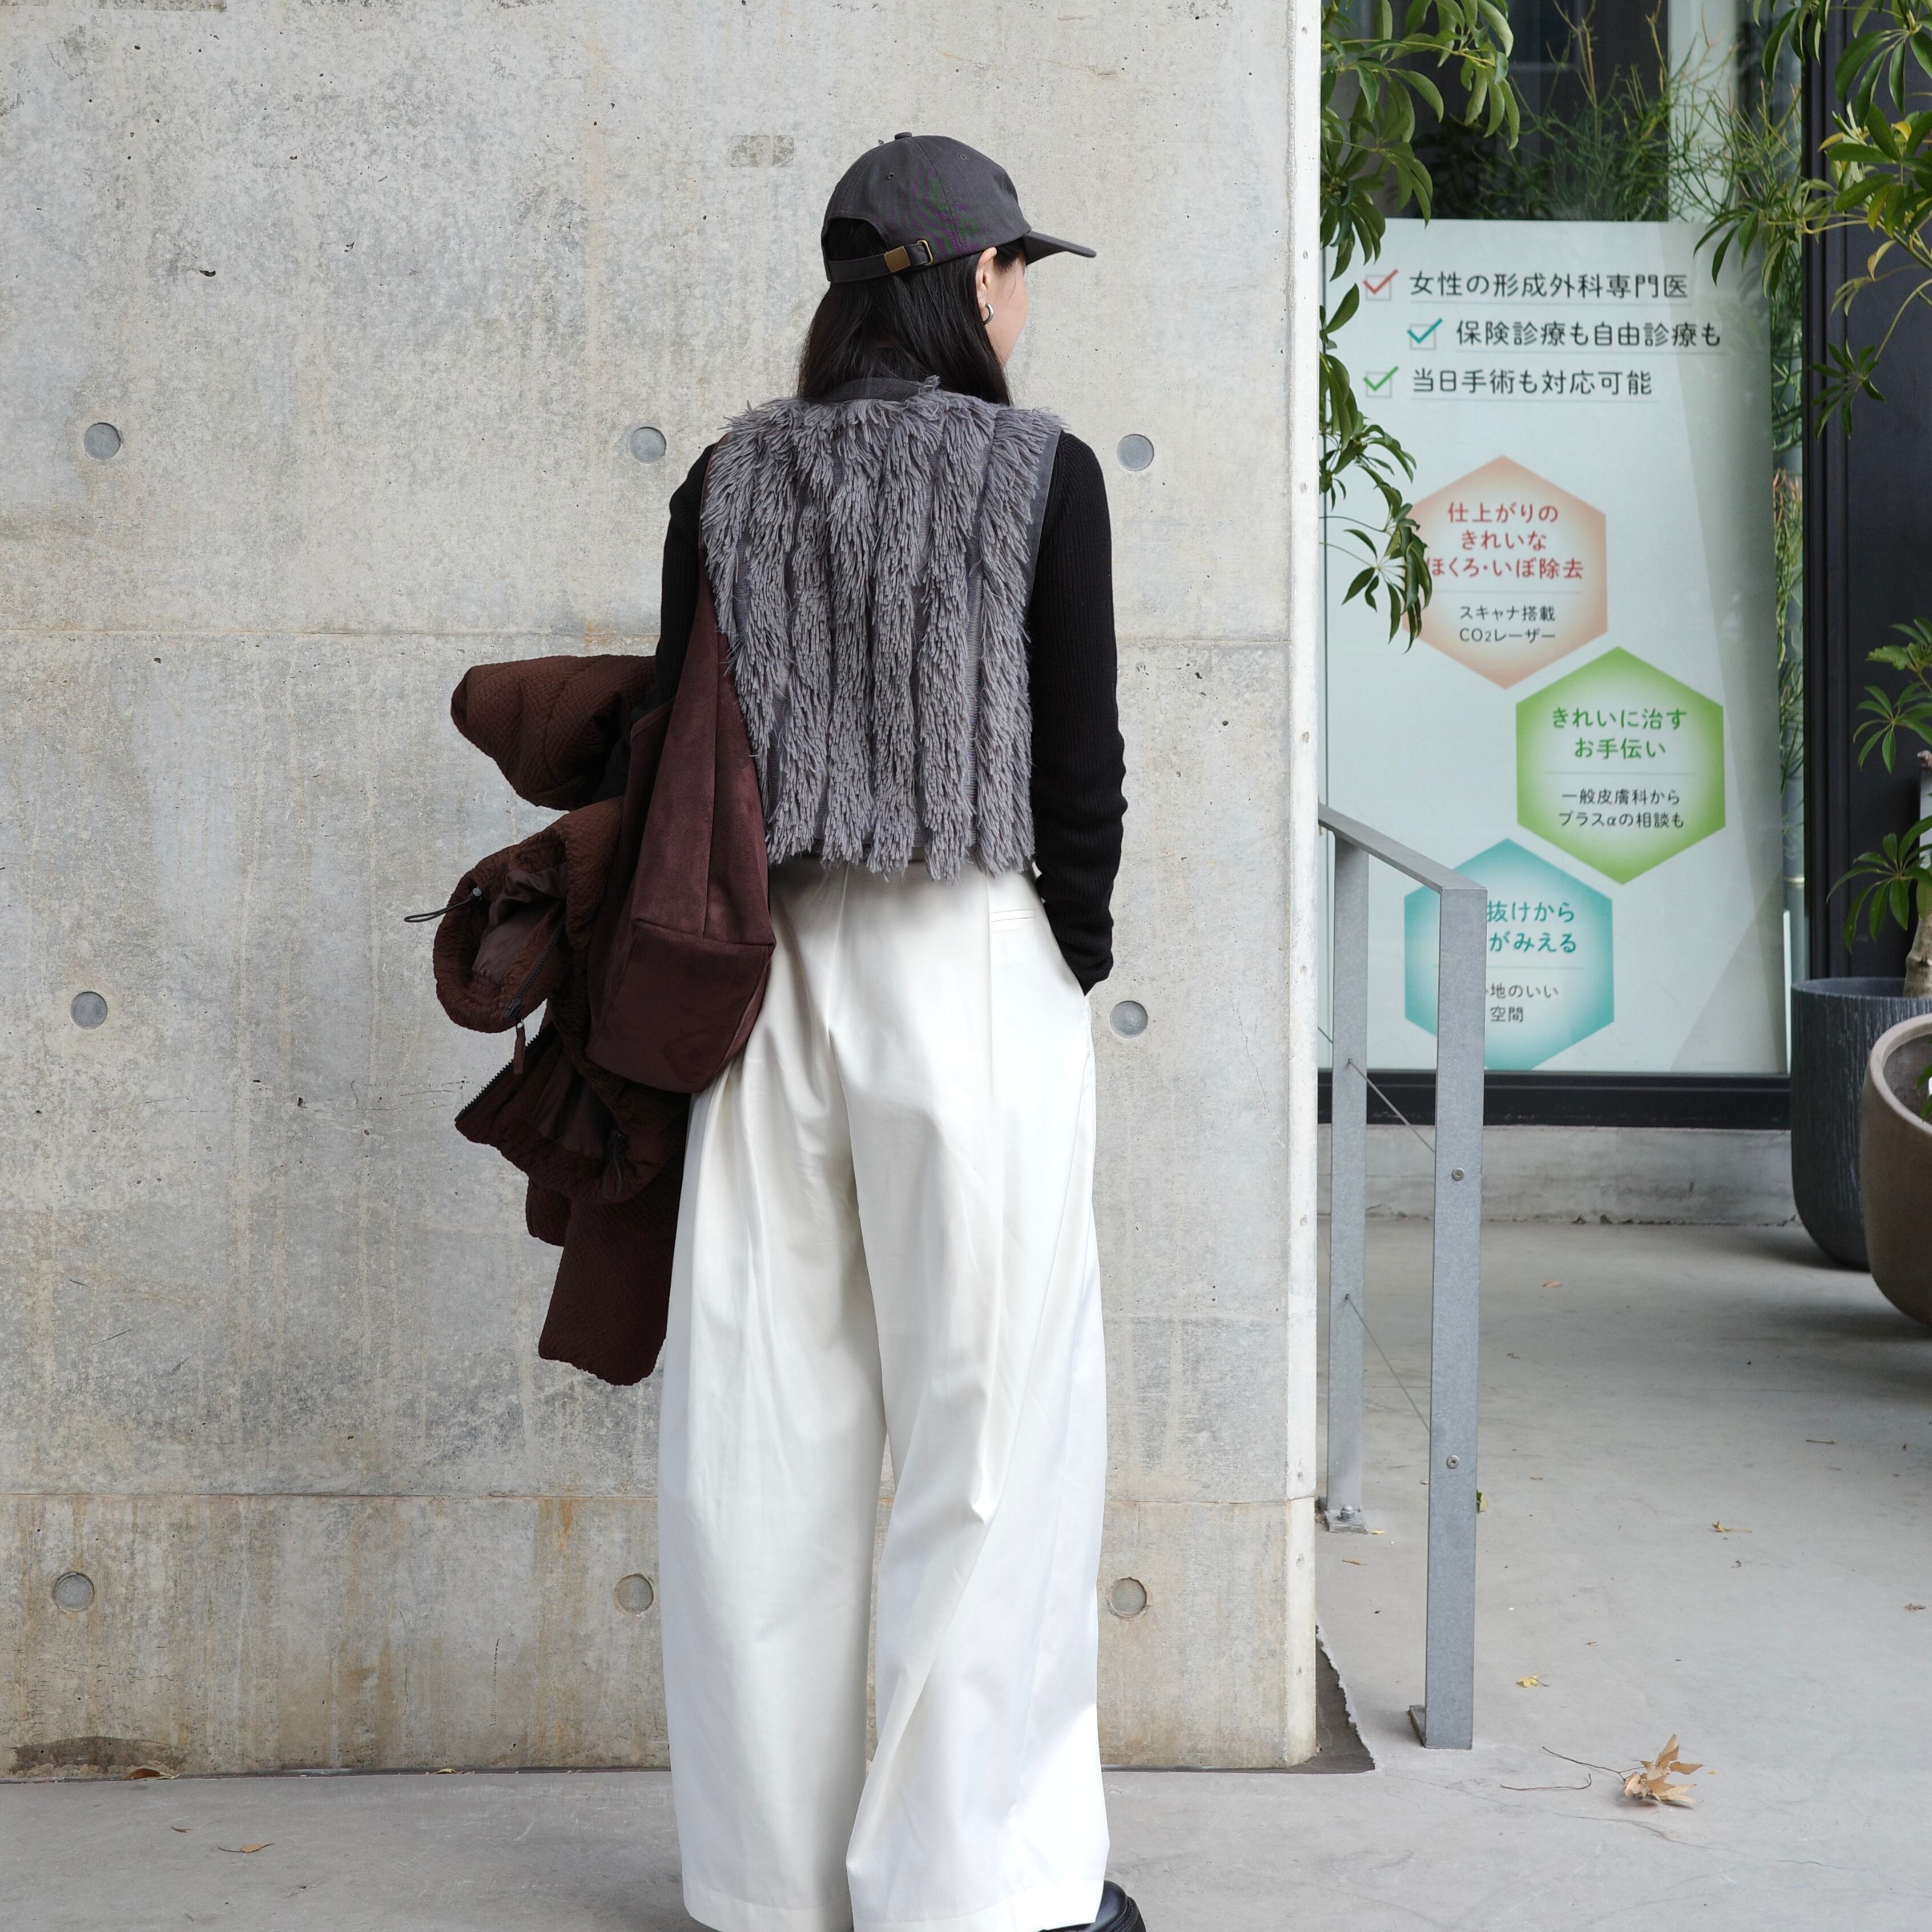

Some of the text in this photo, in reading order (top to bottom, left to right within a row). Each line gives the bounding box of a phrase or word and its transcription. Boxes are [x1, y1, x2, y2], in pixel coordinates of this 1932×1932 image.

[1410, 271, 1688, 299] 女性の形成外科専門医
[1456, 320, 1721, 347] 保険診療も自由診療も
[1412, 367, 1653, 396] 当日手術も対応可能
[1447, 501, 1559, 524] 仕上がりの
[1462, 530, 1547, 550] きれいな
[1426, 557, 1584, 579] ほくろ・いぼ除去
[1460, 605, 1556, 622] スキャナ搭載
[1553, 707, 1687, 730] きれいに治す
[1575, 737, 1666, 759] お手伝い
[1561, 788, 1680, 805] 一般皮膚科から
[1489, 930, 1577, 953] がみえる
[1490, 1005, 1524, 1023] 空間
